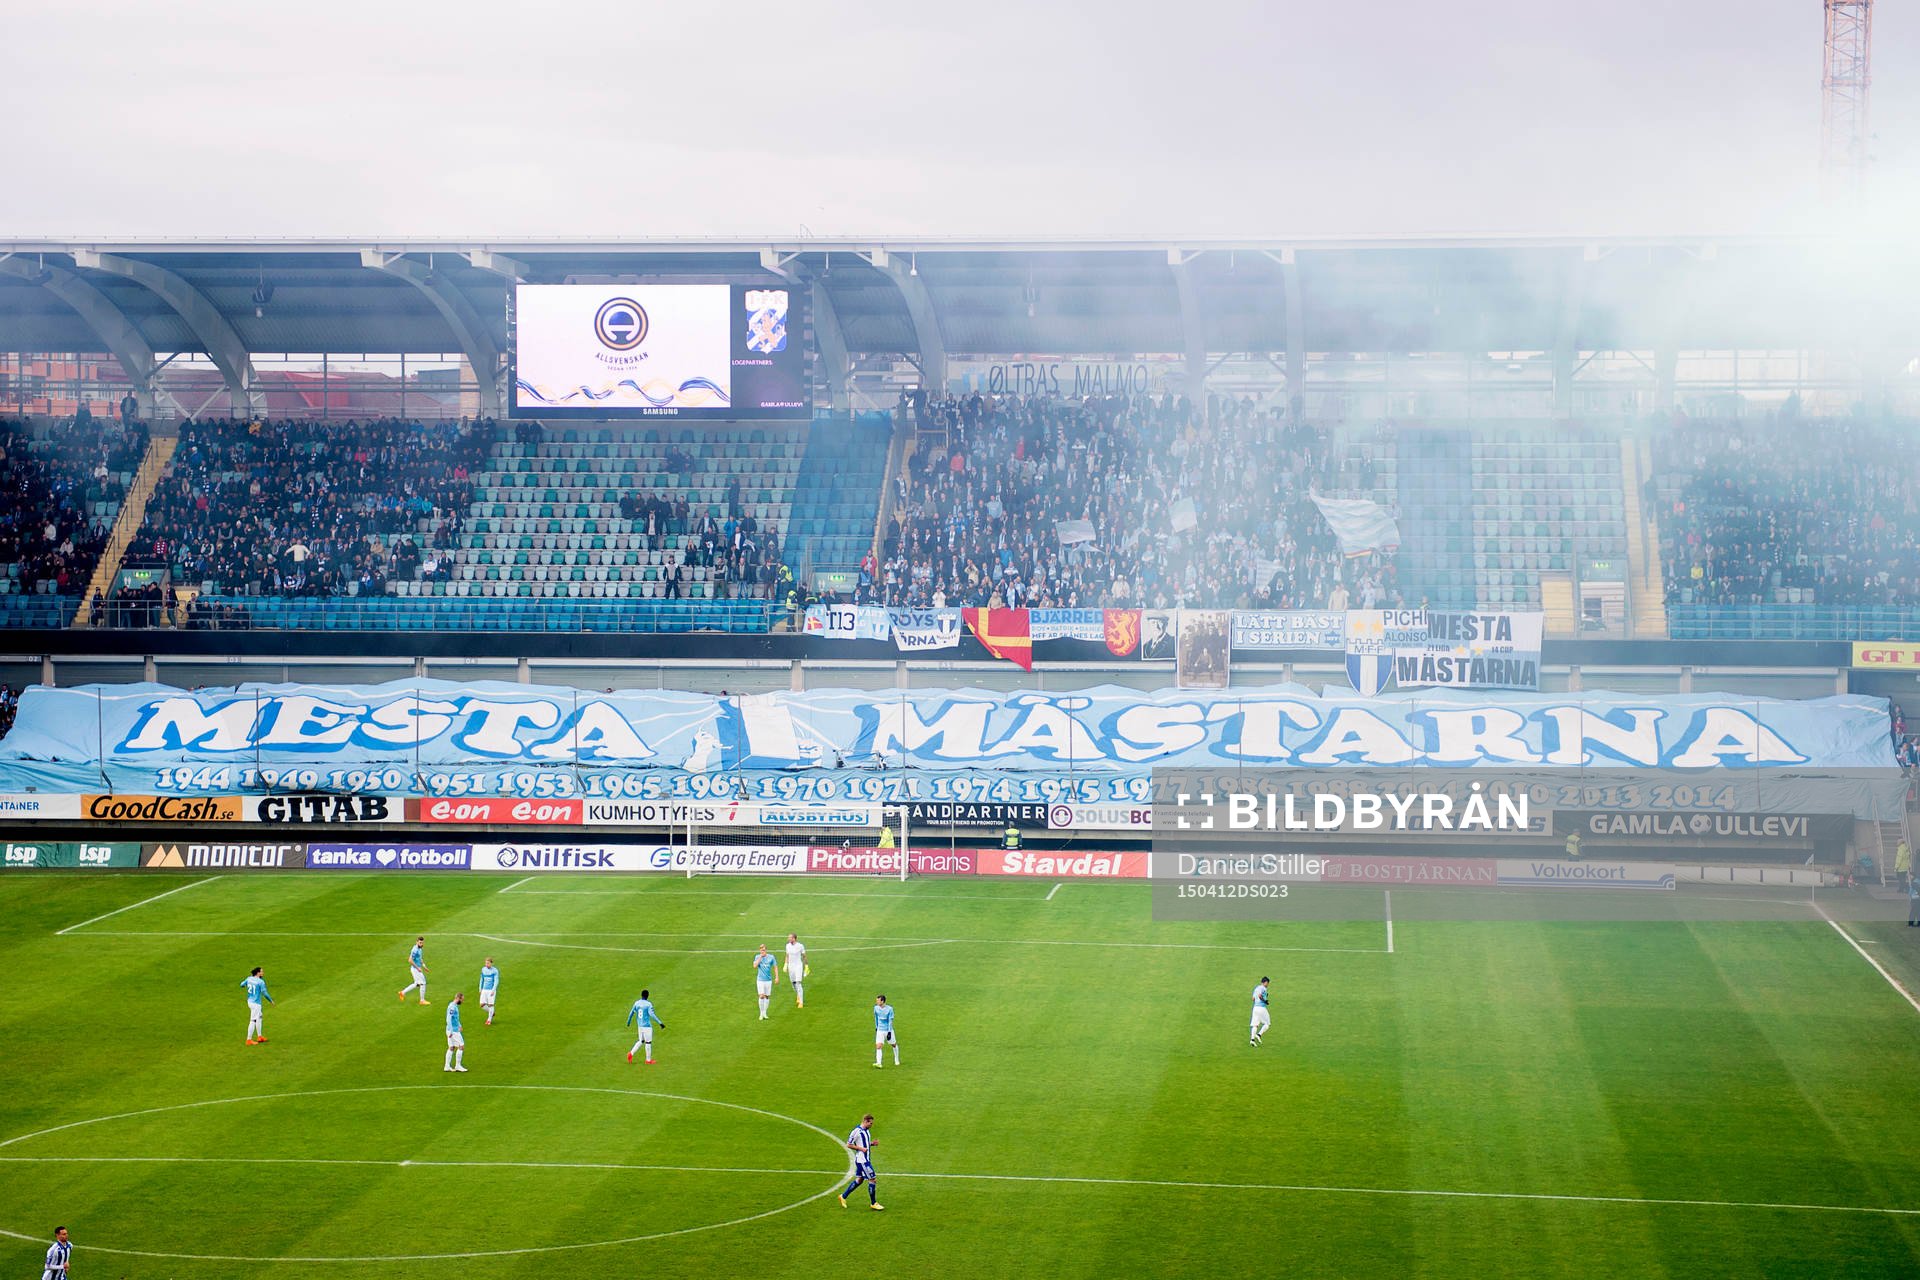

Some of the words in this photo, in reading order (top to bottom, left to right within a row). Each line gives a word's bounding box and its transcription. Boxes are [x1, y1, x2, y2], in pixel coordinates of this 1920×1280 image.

[595, 352, 649, 365] ALLSVENSKAN
[1236, 613, 1287, 629] LÄTT
[1292, 613, 1343, 630] BÄST
[1427, 613, 1512, 642] MESTA
[1250, 631, 1321, 645] SERIEN
[1384, 631, 1428, 641] ALONSO
[1861, 650, 1905, 663] GT
[1397, 653, 1537, 686] MÄSTARNA
[118, 696, 658, 760] MESTA
[862, 695, 1809, 767] MÄSTARNA
[156, 766, 231, 790] 1944
[240, 768, 318, 791] 1949
[327, 769, 402, 793] 1950
[410, 771, 487, 796] 1951
[497, 772, 575, 797] 1953
[586, 774, 663, 799] 1965
[672, 774, 749, 800] 1967
[758, 776, 836, 800] 1970
[845, 776, 921, 801] 1971
[931, 777, 1012, 801] 1974
[1020, 778, 1101, 803] 1975
[1108, 777, 1188, 802] 1977
[1199, 776, 1279, 801] 1986
[1559, 785, 1642, 809] 2013
[1650, 785, 1736, 810] 2014
[90, 795, 234, 820] GoodCash.se
[258, 796, 389, 822] GITAB
[589, 805, 656, 820] KUMHO
[659, 806, 715, 821] TYRES
[1589, 814, 1688, 835] GAMLA
[1715, 815, 1808, 837] ULLEVI
[312, 848, 371, 865] tanka
[400, 848, 467, 865] fotboll
[522, 848, 615, 867] Nilfisk
[676, 850, 746, 868] Göteborg
[749, 851, 797, 869] Energi
[1002, 851, 1122, 875] Stavdal
[1350, 862, 1493, 883] BOSTJÄRNAN
[1531, 862, 1626, 880] Volvokort
